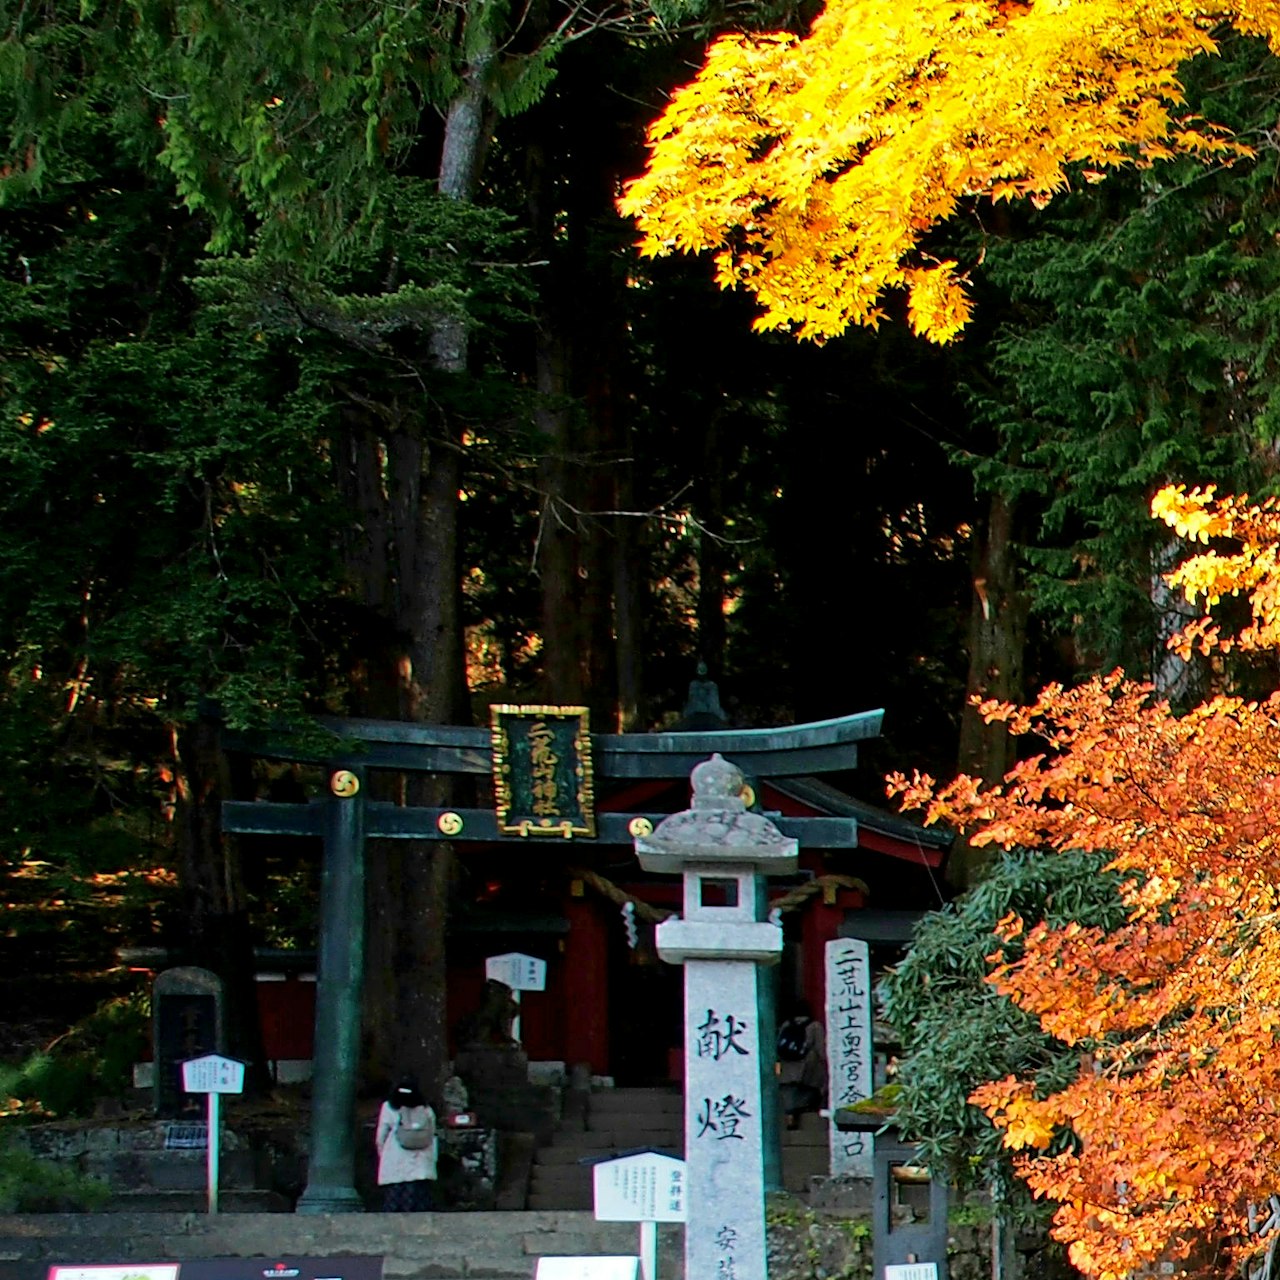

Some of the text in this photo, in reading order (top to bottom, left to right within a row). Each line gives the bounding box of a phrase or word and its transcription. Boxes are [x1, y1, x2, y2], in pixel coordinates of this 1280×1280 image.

[527, 722, 560, 816] 二荒山神社
[834, 949, 866, 1157] 二荒山上奥宮登口
